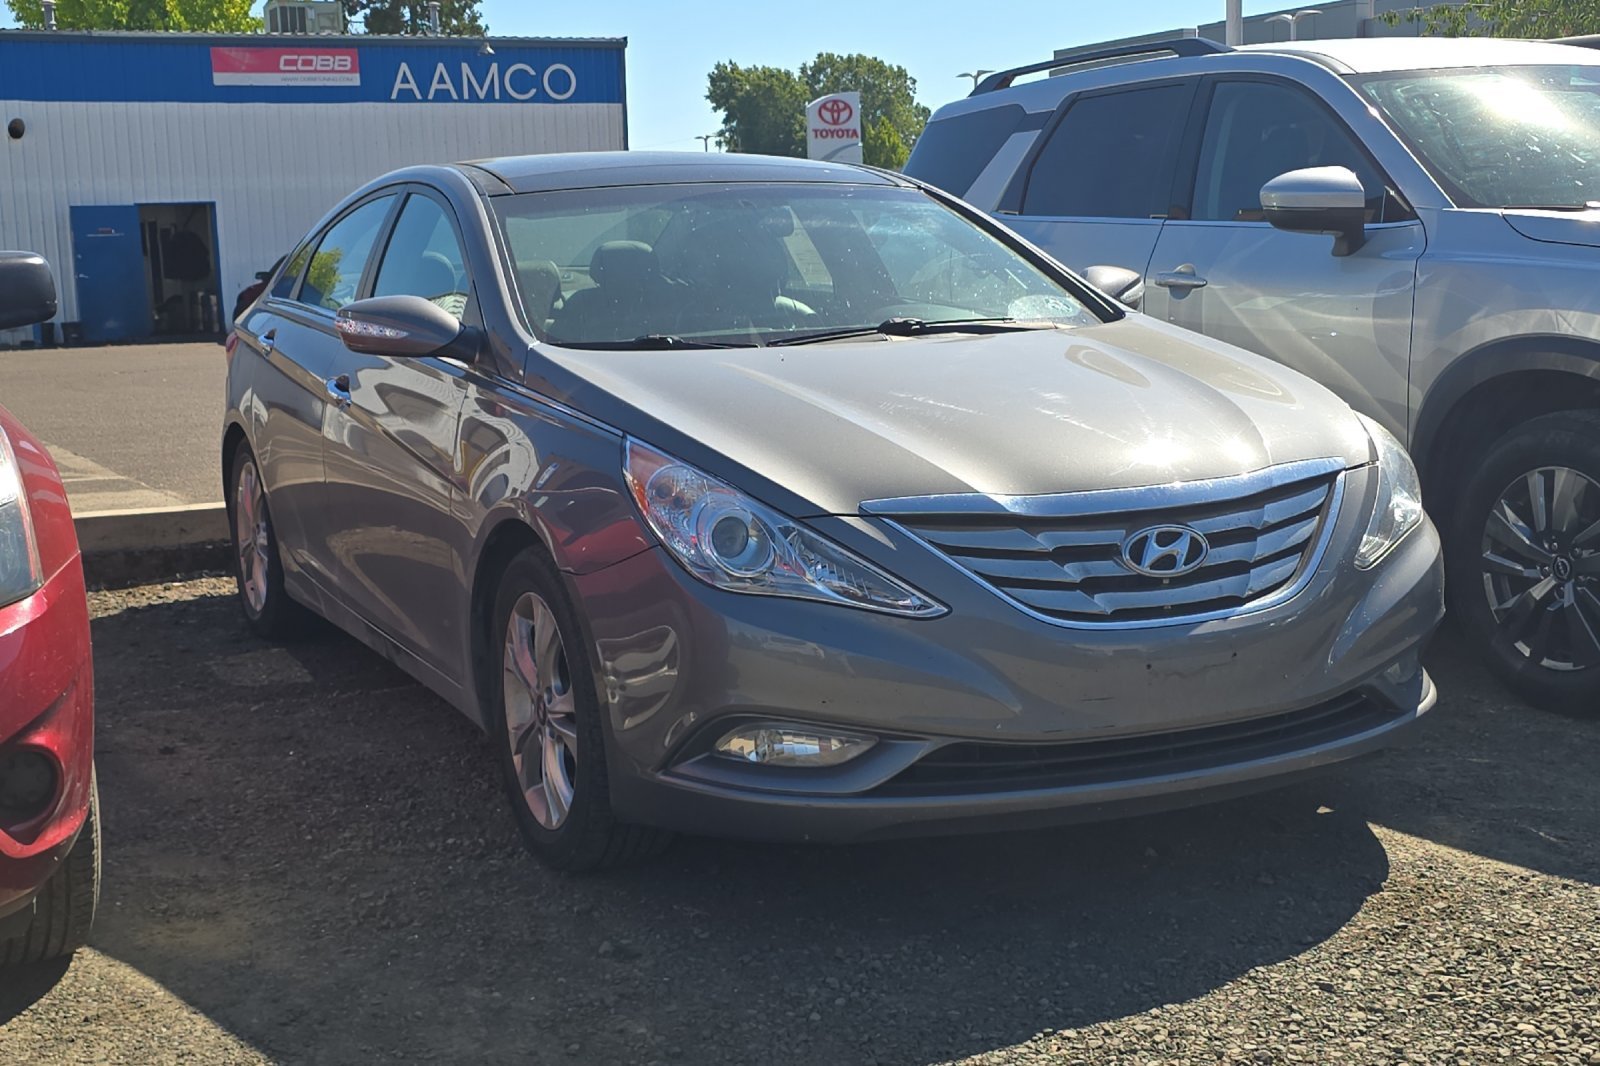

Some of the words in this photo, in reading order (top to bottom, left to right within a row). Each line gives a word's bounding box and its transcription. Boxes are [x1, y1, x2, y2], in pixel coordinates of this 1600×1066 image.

[279, 54, 352, 71] COBB
[390, 62, 577, 100] AAMCO
[812, 128, 859, 139] TOYOTA
